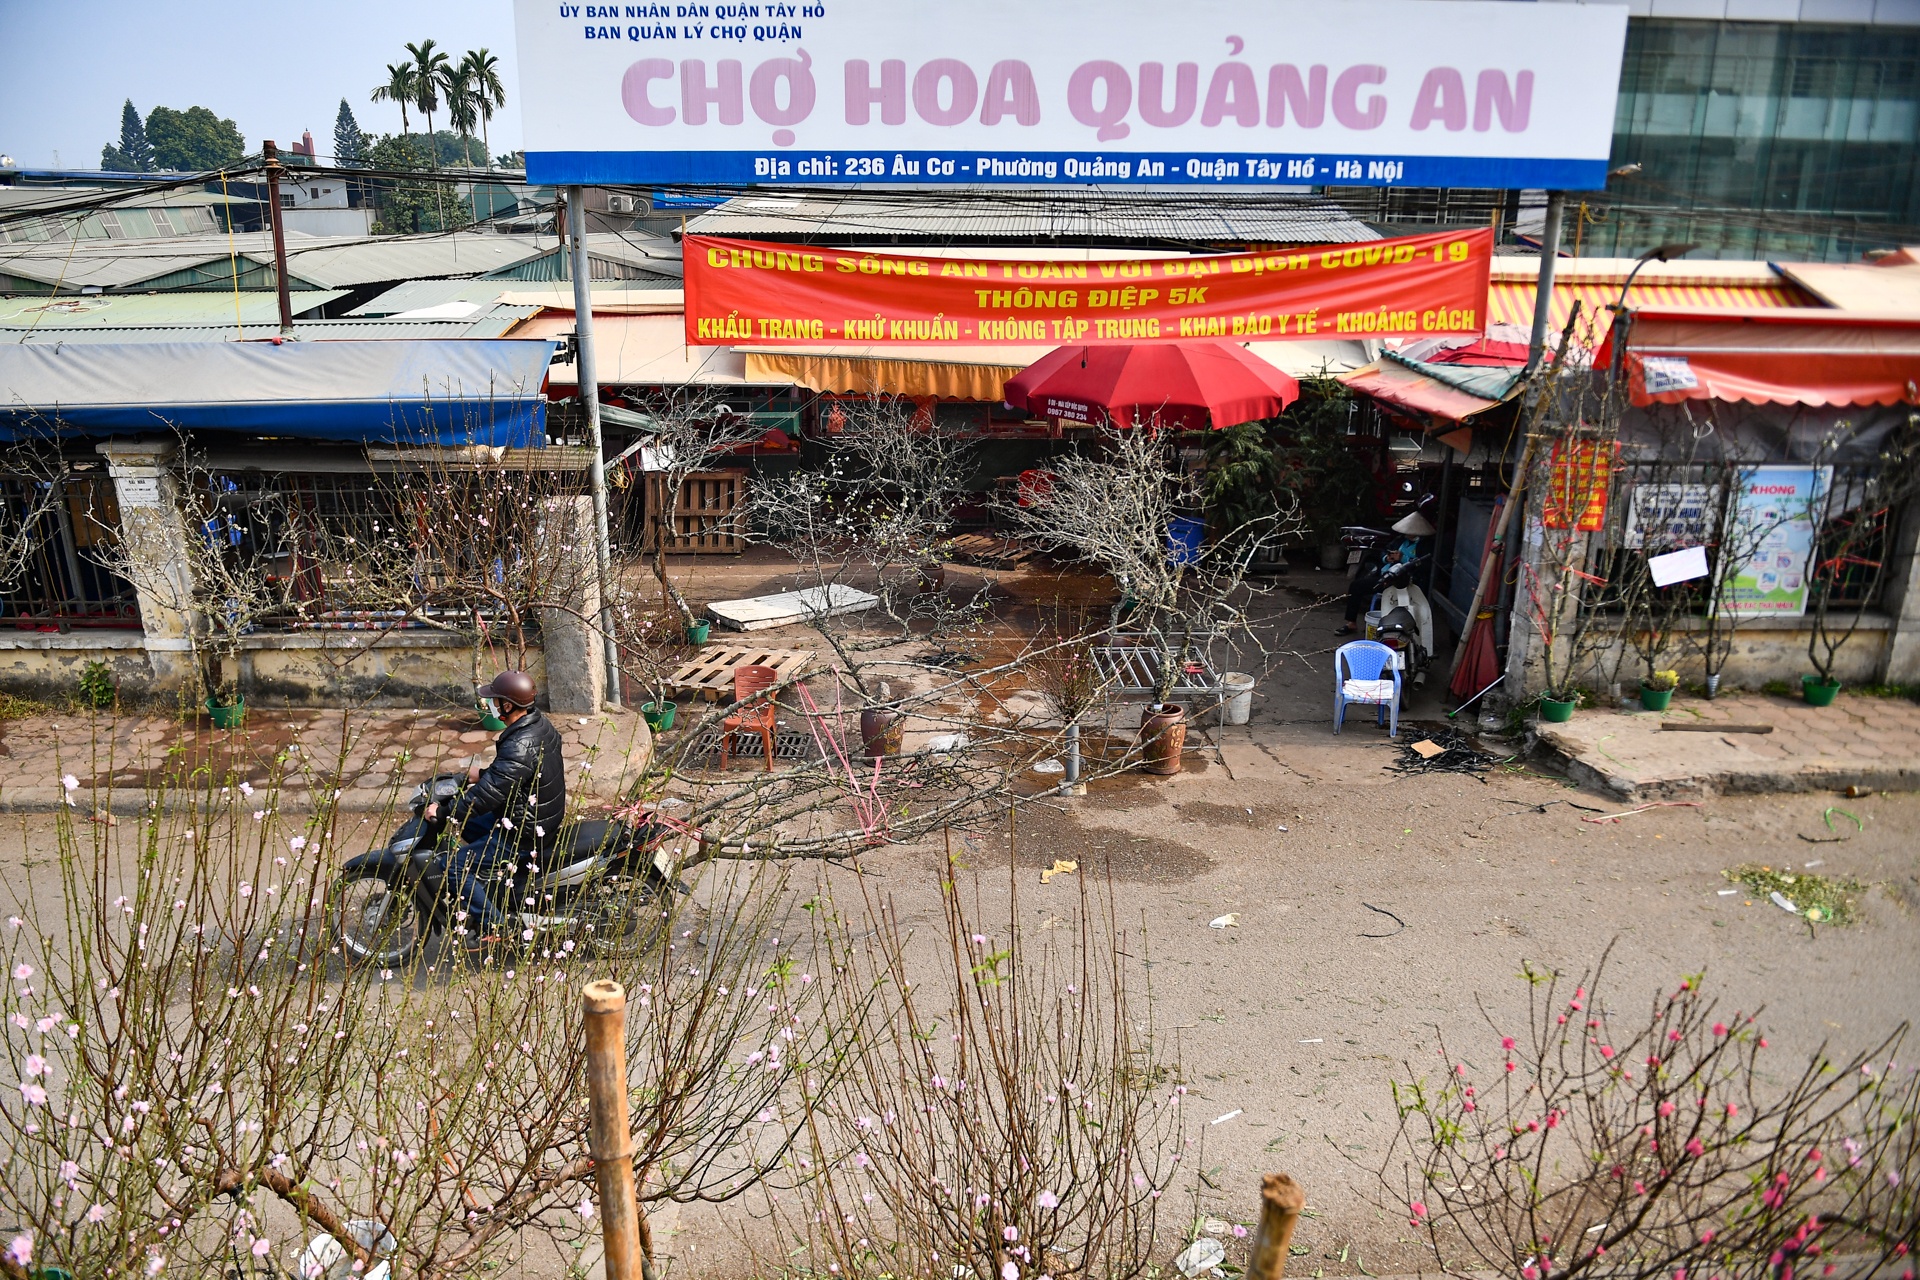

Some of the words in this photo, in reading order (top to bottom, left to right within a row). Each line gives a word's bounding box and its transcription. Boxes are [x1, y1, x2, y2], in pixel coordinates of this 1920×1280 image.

[560, 2, 579, 18] ỦY
[587, 5, 618, 18] BAN
[626, 2, 670, 18] NHÂN
[677, 2, 709, 17] DÂN
[716, 2, 759, 20] QUẬN
[765, 2, 797, 17] TÂY
[803, 0, 825, 17] HỒ
[584, 26, 621, 39] BAN
[628, 22, 677, 42] QUẢN
[684, 21, 703, 39] LÝ
[710, 24, 747, 43] CHỢ
[753, 24, 802, 42] QUẬN
[621, 47, 816, 147] CHỢ
[845, 58, 1041, 126] HOA
[1067, 35, 1388, 142] QUẢNG
[1409, 66, 1534, 133] AN
[754, 157, 791, 178] Địa
[797, 154, 838, 176] chỉ:
[845, 157, 885, 176] 236
[891, 153, 920, 176] Âu
[926, 156, 955, 176] Cơ
[976, 157, 1057, 178] Phường
[1064, 156, 1131, 179] Quảng
[1137, 158, 1165, 177] An
[1186, 158, 1240, 181] Quận
[1245, 158, 1282, 179] Tây
[1287, 157, 1315, 179] Hồ
[1335, 159, 1363, 180] Hà
[1368, 160, 1404, 183] Nội
[707, 247, 824, 273] CHUNG
[836, 252, 929, 277] SỐNG
[940, 261, 989, 278] AN
[997, 258, 1088, 279] TOÀN
[1100, 259, 1153, 279] VỚI
[1163, 258, 1221, 281] ĐẠI
[1231, 254, 1311, 277] DỊCH
[1320, 240, 1470, 269] COVID-19
[974, 286, 1079, 309] THÔNG
[1087, 285, 1160, 311] ĐIỆP
[1167, 286, 1209, 305] 5K
[697, 309, 753, 340] KHẨU
[757, 317, 824, 340] TRANG
[843, 312, 887, 341] KHỬ
[889, 312, 959, 341] KHUẨN
[978, 316, 1046, 341] KHÔNG
[1051, 315, 1091, 345] TẬP
[1094, 317, 1161, 340] TRUNG
[1179, 315, 1227, 338] KHAI
[1231, 310, 1272, 337] BÁO
[1278, 313, 1292, 335] Y
[1294, 306, 1320, 335] TẾ
[1337, 304, 1418, 334] KHOẢNG
[1422, 304, 1476, 332] CÁCH
